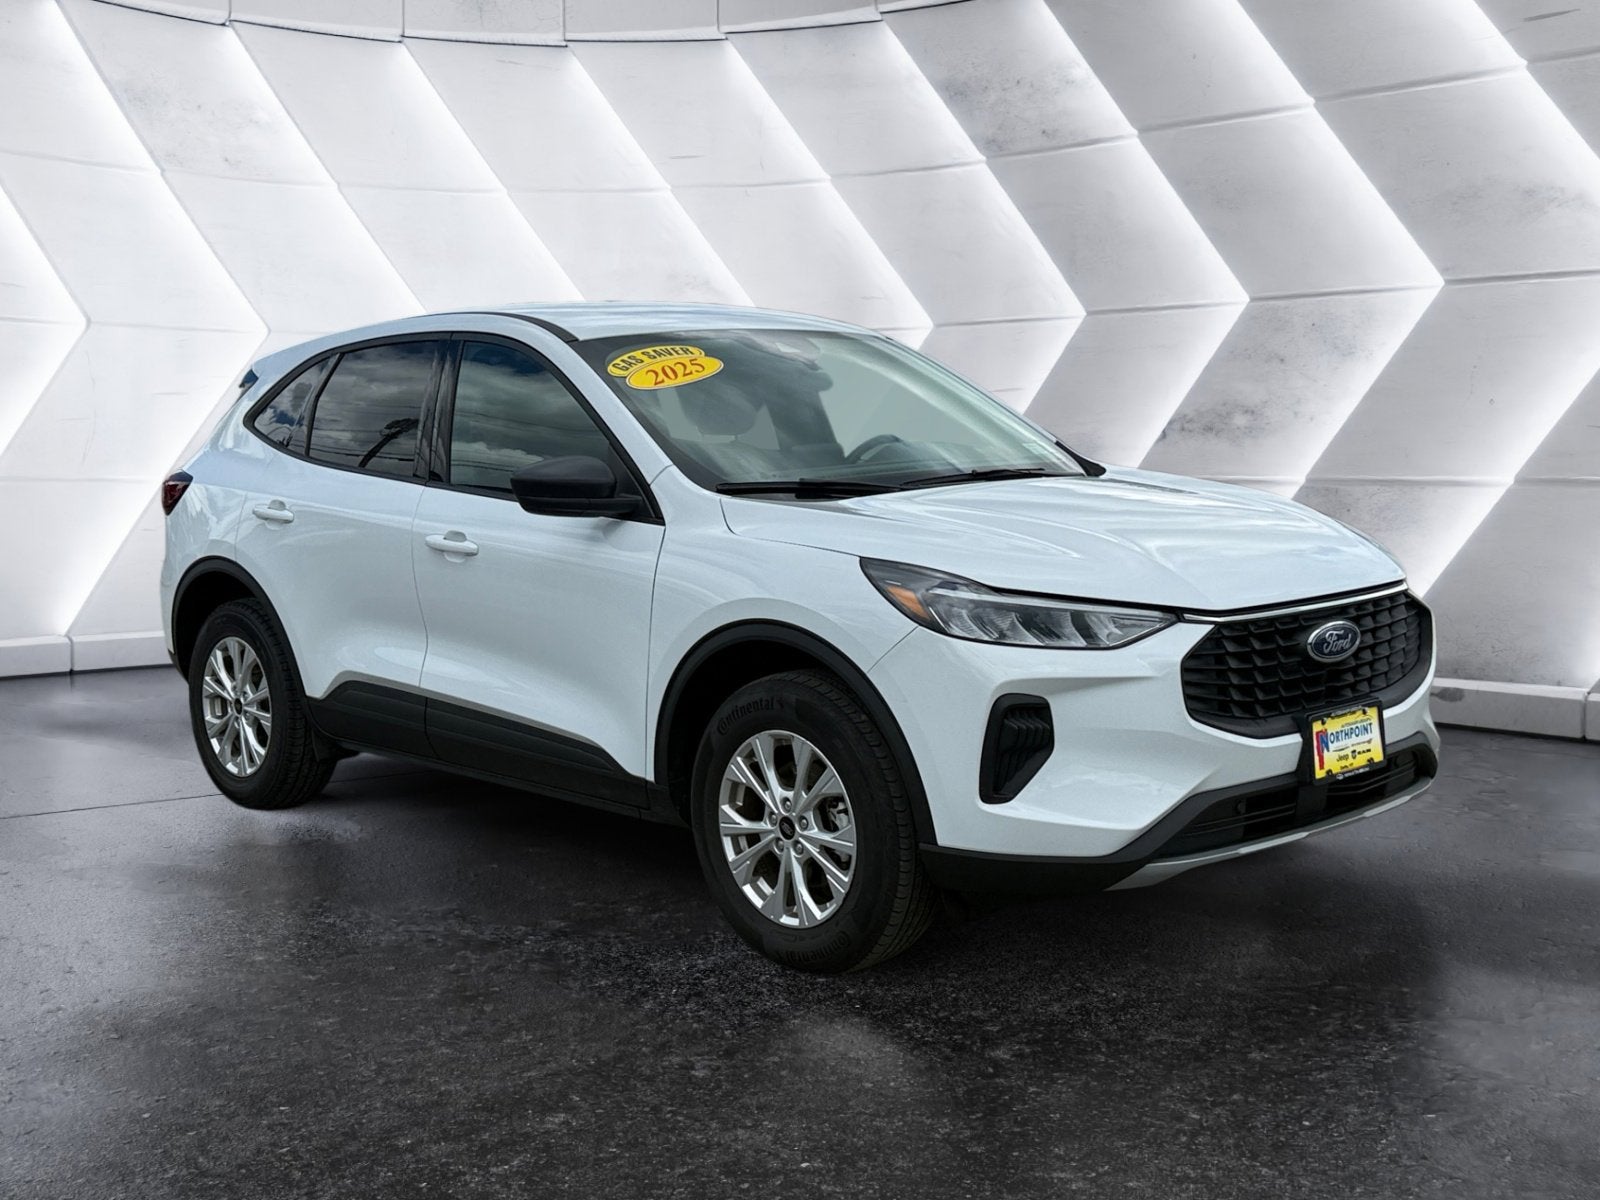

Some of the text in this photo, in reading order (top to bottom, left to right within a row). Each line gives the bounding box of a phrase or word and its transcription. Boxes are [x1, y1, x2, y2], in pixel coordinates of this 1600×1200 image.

[612, 346, 695, 371] GAS SAVER
[645, 358, 705, 386] 2025
[1323, 630, 1352, 654] Ford
[717, 697, 775, 735] Continental
[1319, 722, 1373, 752] NORTHPOINT
[1336, 753, 1349, 762] Jeep
